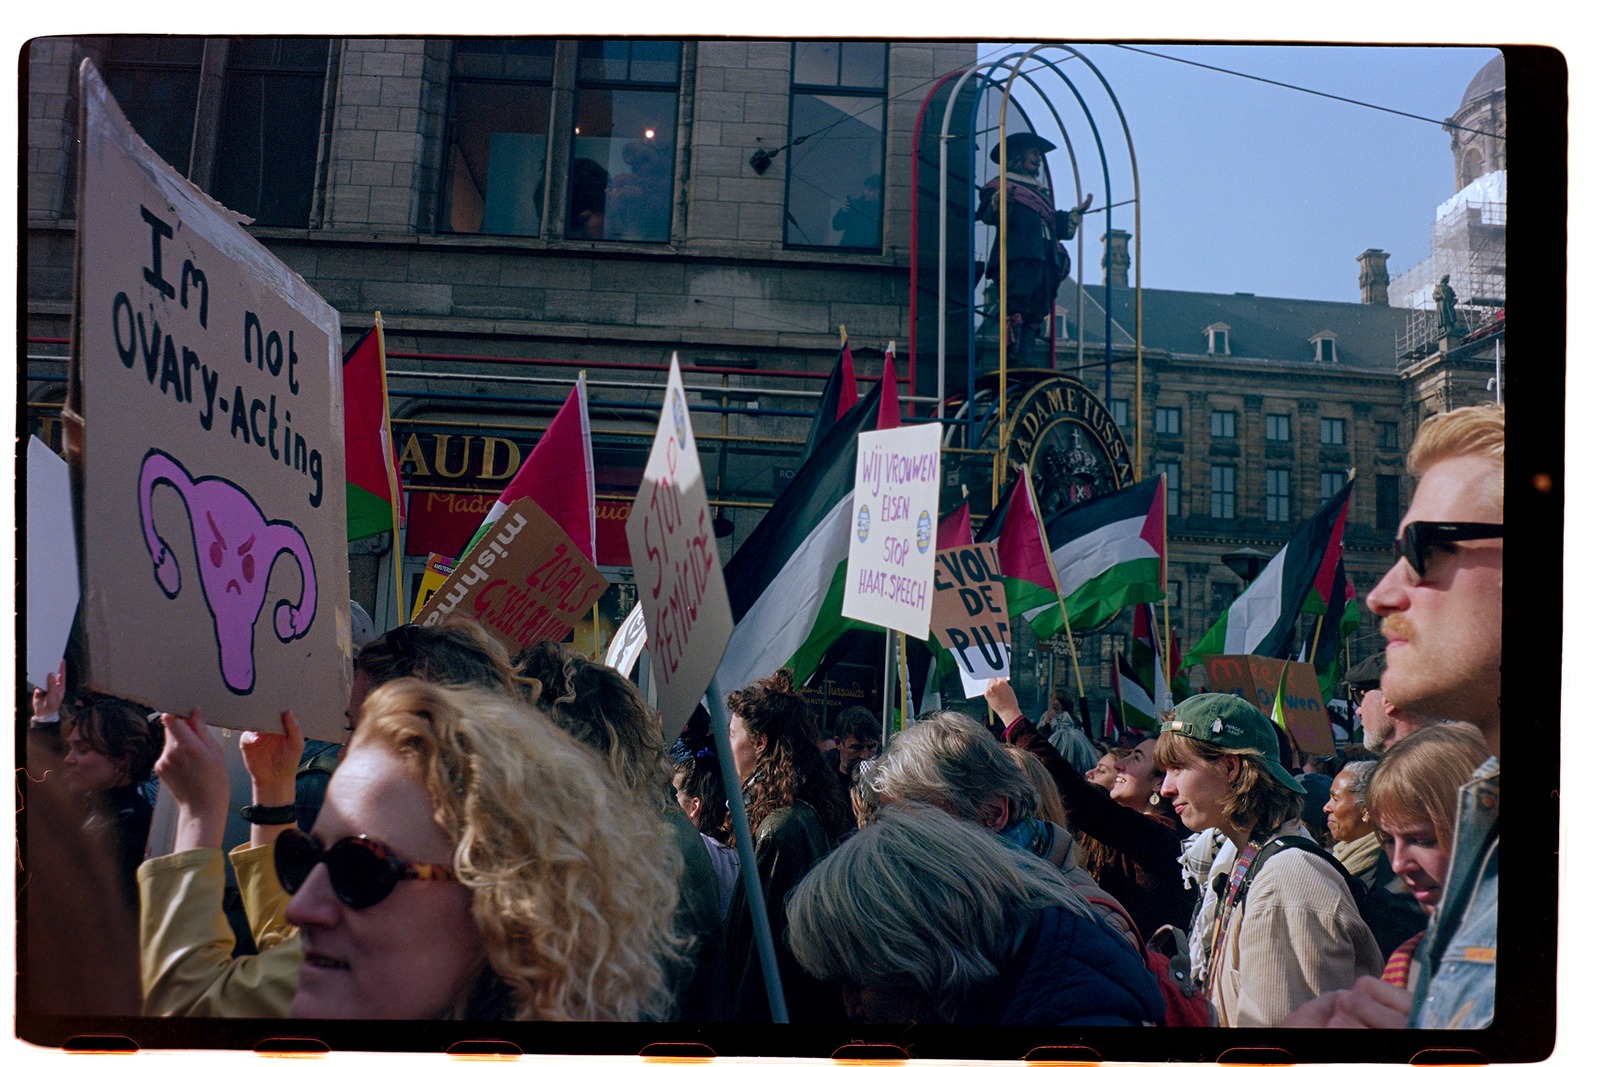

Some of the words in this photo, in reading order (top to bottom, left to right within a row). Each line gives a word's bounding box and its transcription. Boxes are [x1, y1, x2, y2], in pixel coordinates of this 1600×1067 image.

[245, 310, 299, 395] not
[645, 435, 682, 600] STOP
[883, 536, 909, 567] STOP
[958, 585, 1002, 617] DE
